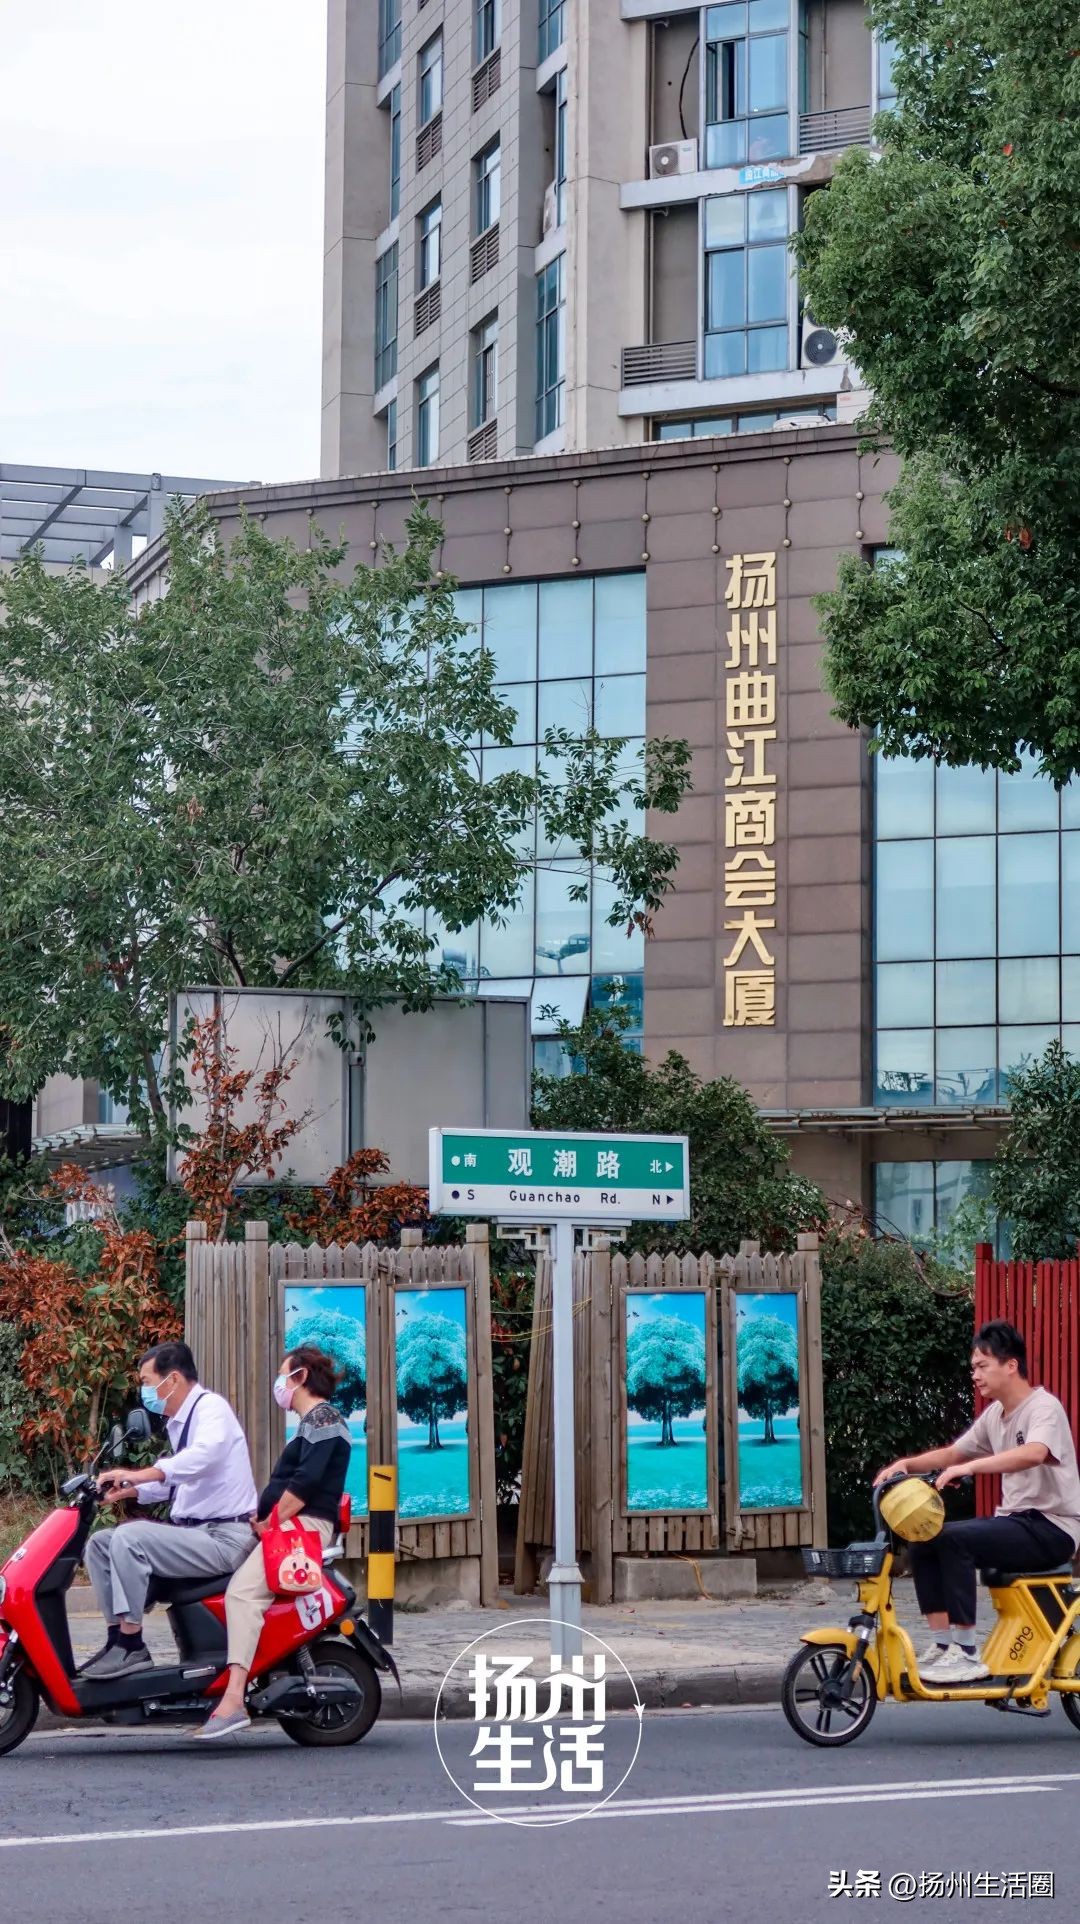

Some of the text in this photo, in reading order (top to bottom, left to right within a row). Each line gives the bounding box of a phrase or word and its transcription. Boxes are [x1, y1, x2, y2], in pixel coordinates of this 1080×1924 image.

[723, 551, 777, 1027] 扬州曲江商会大厦
[464, 1148, 662, 1180] 南 观潮路 北
[467, 1189, 661, 1205] S Guanchao Rd. N
